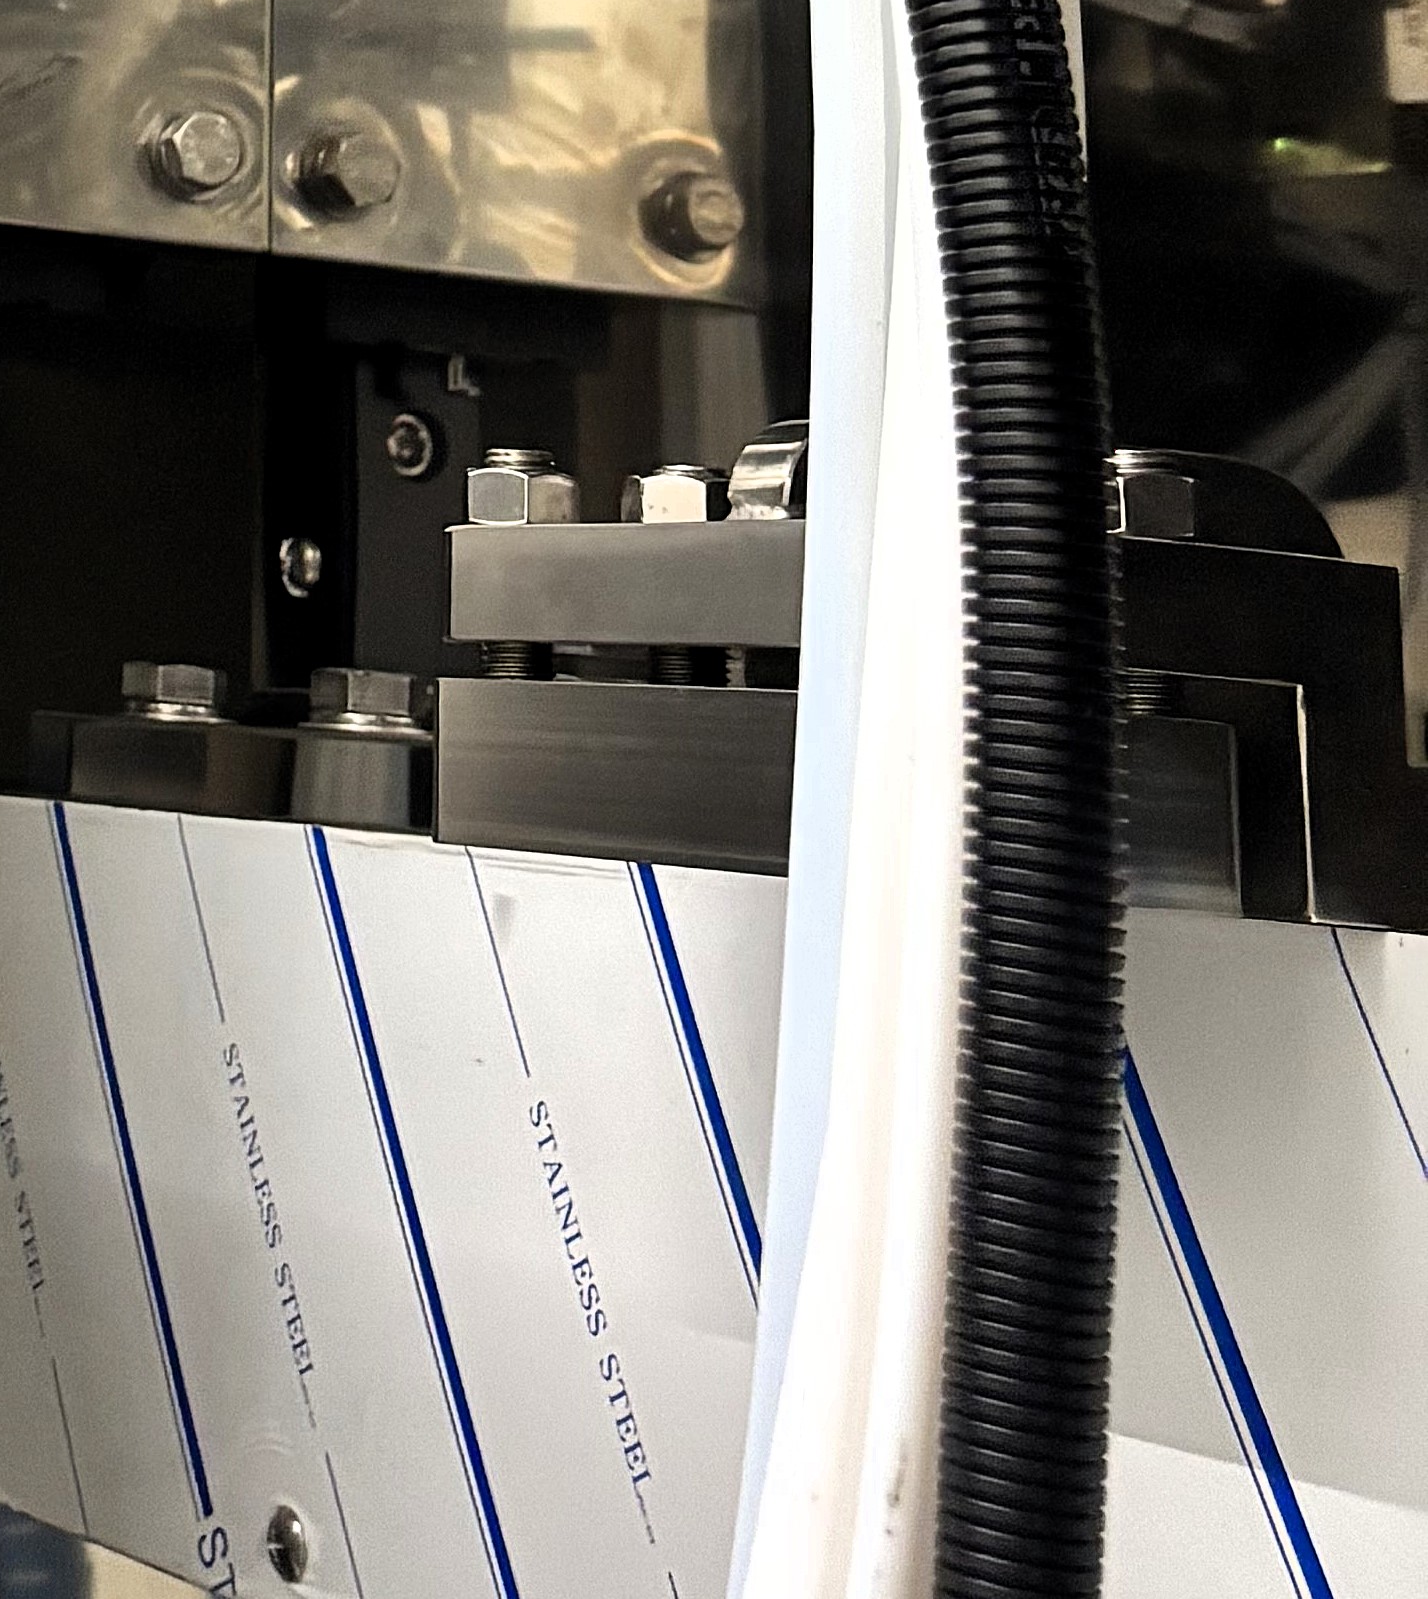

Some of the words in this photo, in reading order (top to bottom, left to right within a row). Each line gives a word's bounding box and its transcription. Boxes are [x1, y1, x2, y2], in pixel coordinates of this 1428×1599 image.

[222, 1042, 283, 1250] STAINLESS
[274, 1261, 315, 1384] STEEL
[528, 1099, 608, 1338] STAINLESS
[598, 1352, 653, 1505] STEEL
